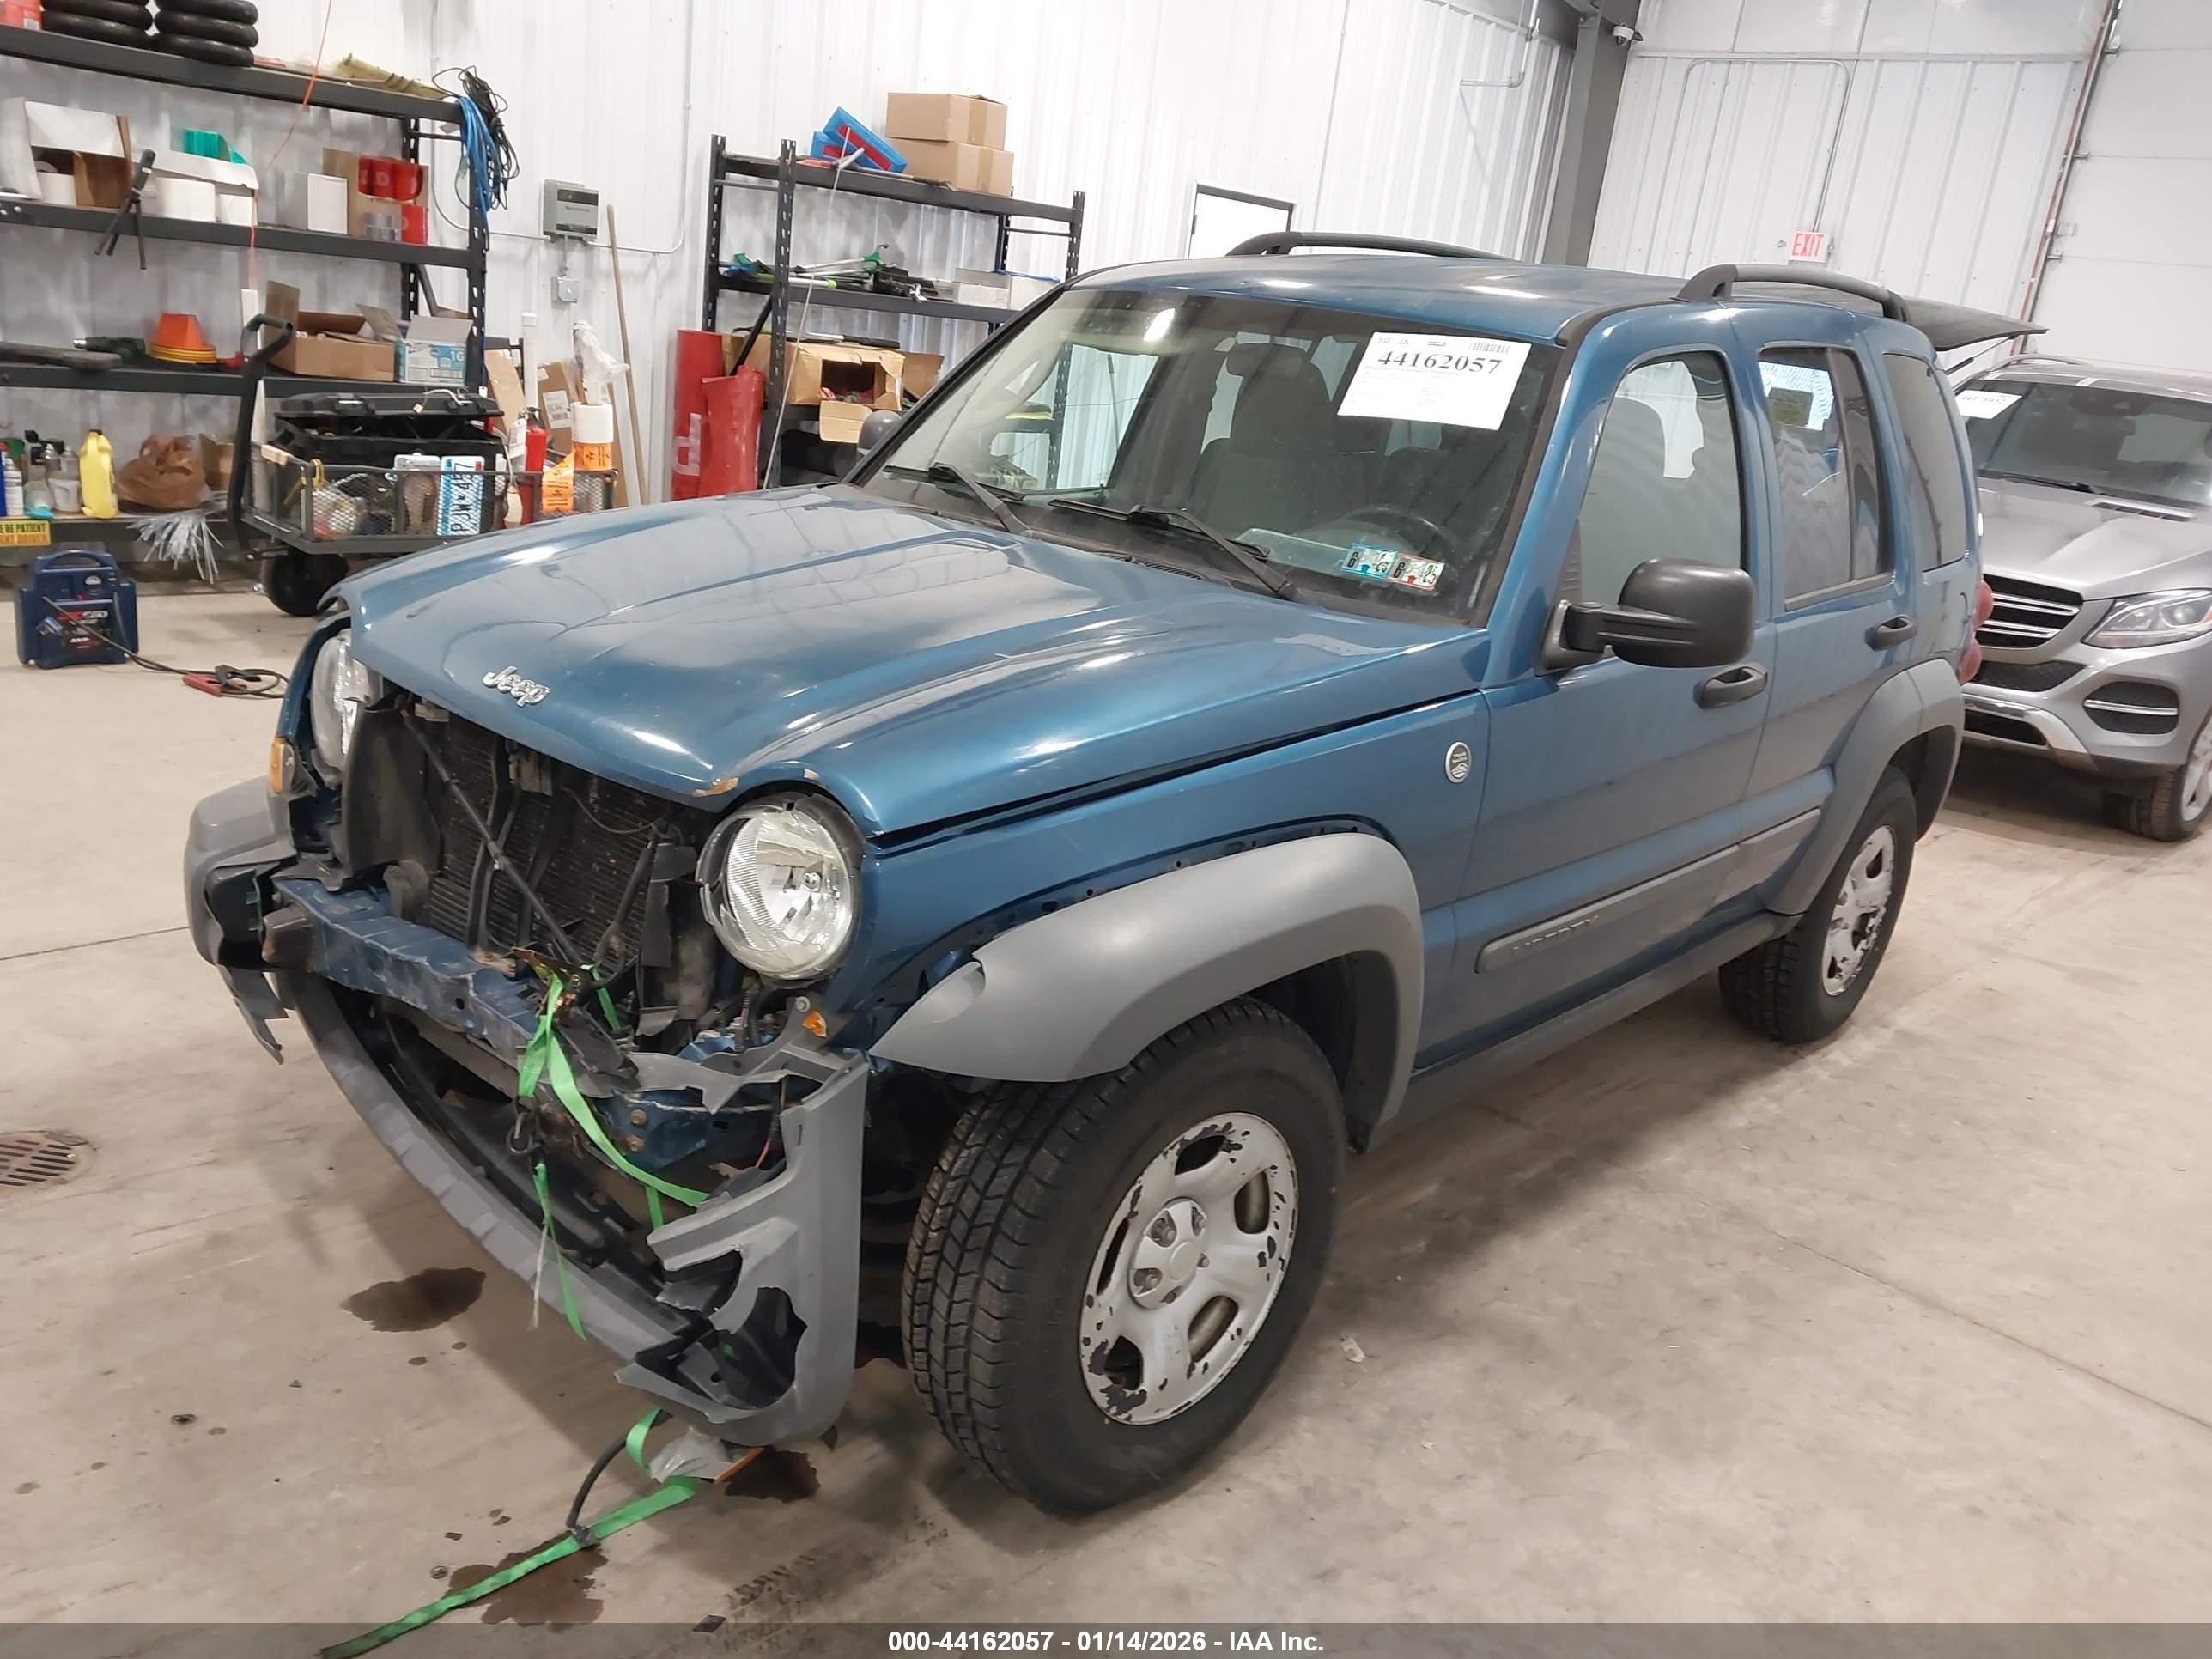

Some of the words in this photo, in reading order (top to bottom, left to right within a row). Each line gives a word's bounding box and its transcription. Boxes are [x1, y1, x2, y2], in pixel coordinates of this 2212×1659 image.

[1791, 233, 1825, 257] EXIT
[1377, 350, 1502, 374] 44162057
[1347, 551, 1359, 568] 6
[1393, 562, 1406, 578] 6
[482, 665, 550, 707] Jeep
